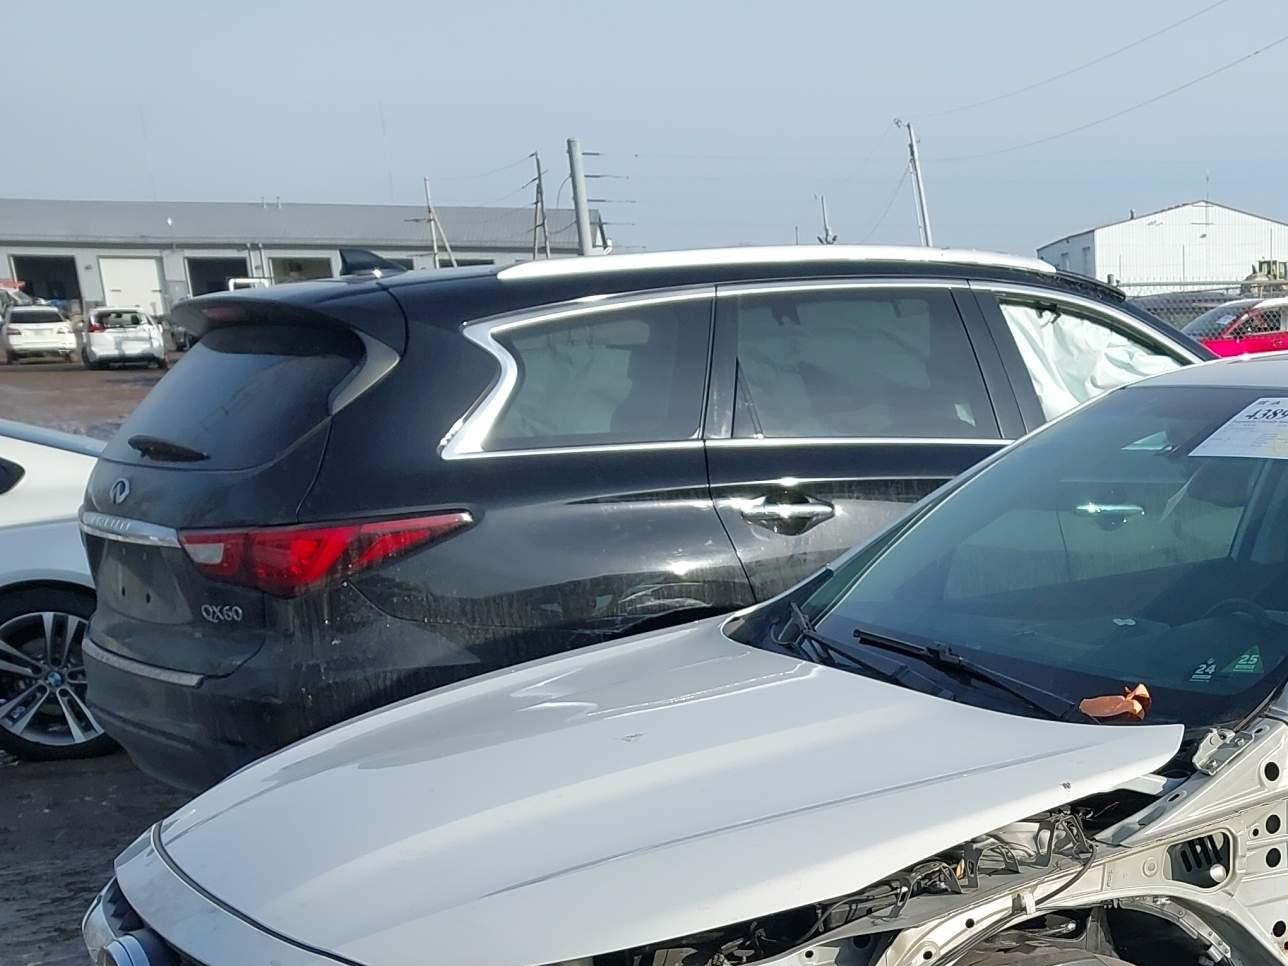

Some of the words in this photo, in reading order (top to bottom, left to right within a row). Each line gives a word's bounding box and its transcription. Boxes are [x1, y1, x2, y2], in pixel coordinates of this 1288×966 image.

[201, 604, 243, 623] QX60
[1237, 654, 1260, 665] 25
[1194, 664, 1217, 675] 24
